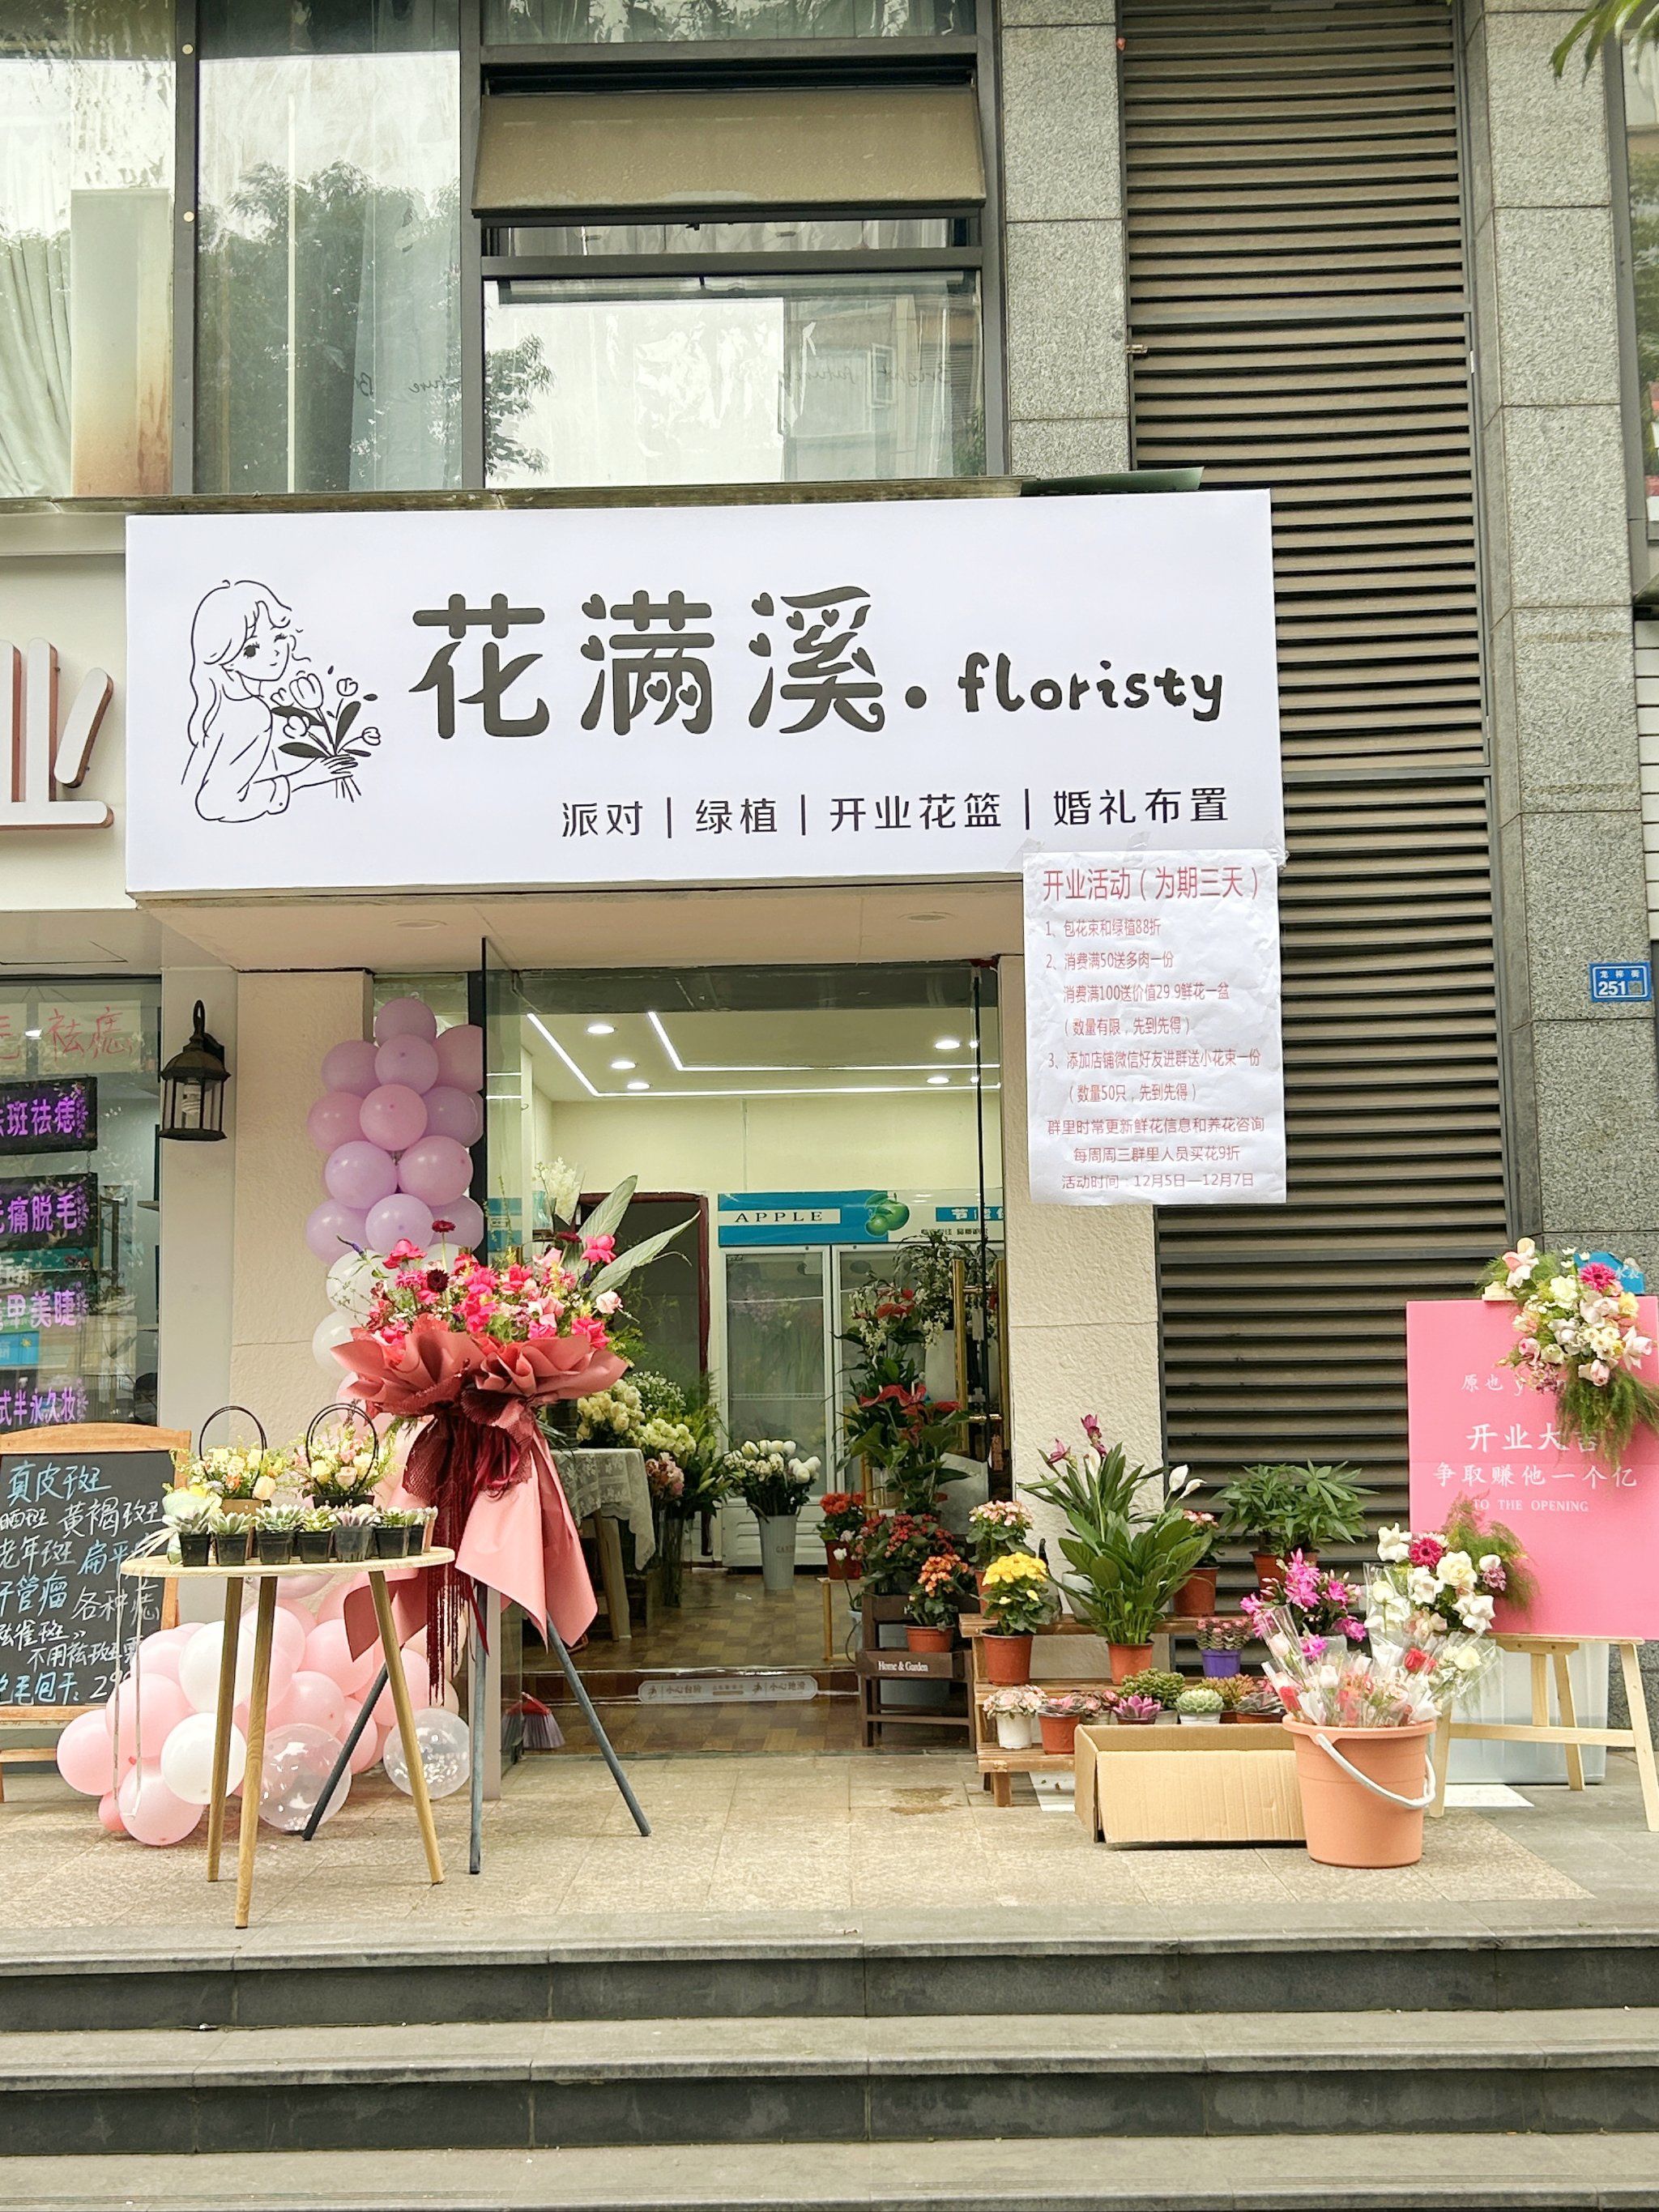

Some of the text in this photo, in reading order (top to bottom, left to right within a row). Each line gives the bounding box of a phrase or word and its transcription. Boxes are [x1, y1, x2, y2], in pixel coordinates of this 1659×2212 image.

[407, 586, 1222, 739] 花满溪 floristy
[562, 786, 1229, 837] 派对 绿植 开业花篮 婚礼布置
[1598, 981, 1626, 995] 251
[0, 1097, 76, 1136] 斑祛痣
[0, 1195, 76, 1234] 痛脱毛
[735, 1211, 822, 1223] APPLE
[0, 1289, 76, 1329] 甲美睫
[1433, 1461, 1637, 1489] 争取赚他一个亿
[1499, 1499, 1523, 1511] THE
[1531, 1499, 1589, 1512] OPENING
